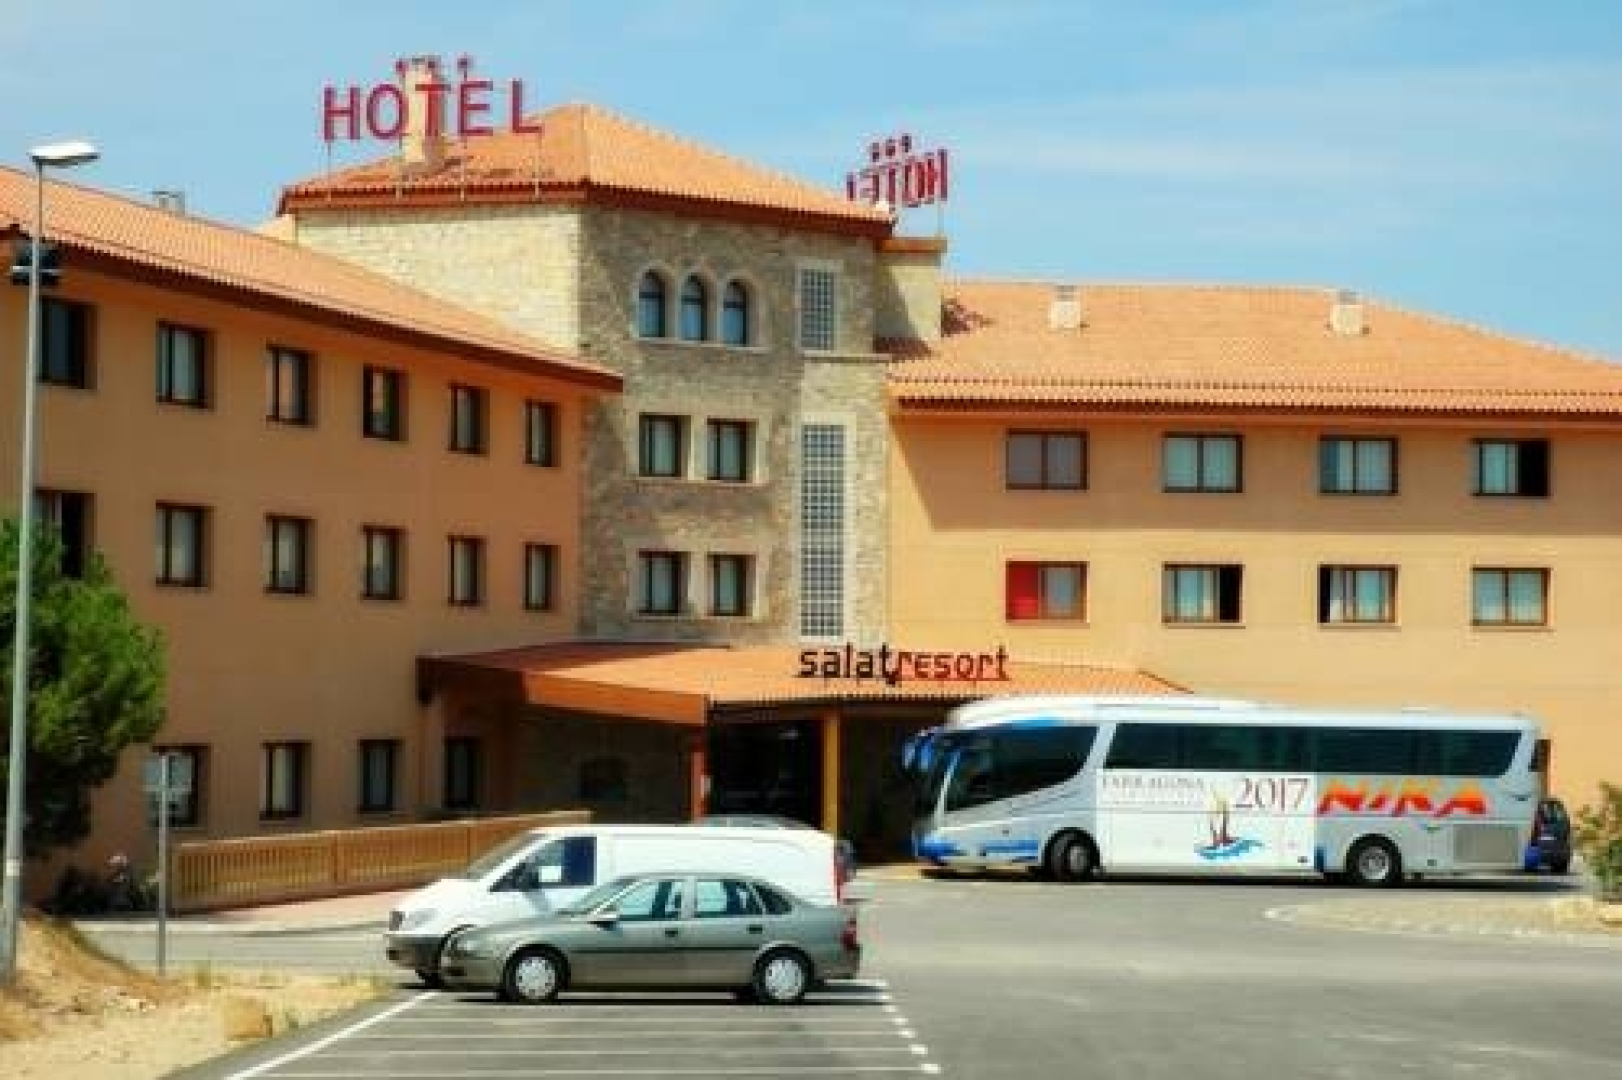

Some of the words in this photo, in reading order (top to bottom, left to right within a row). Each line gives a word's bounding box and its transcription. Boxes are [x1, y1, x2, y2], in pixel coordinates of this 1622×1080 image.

[323, 80, 542, 141] HOTEL
[1235, 777, 1309, 811] 2017
[1317, 778, 1488, 818] NIKA
